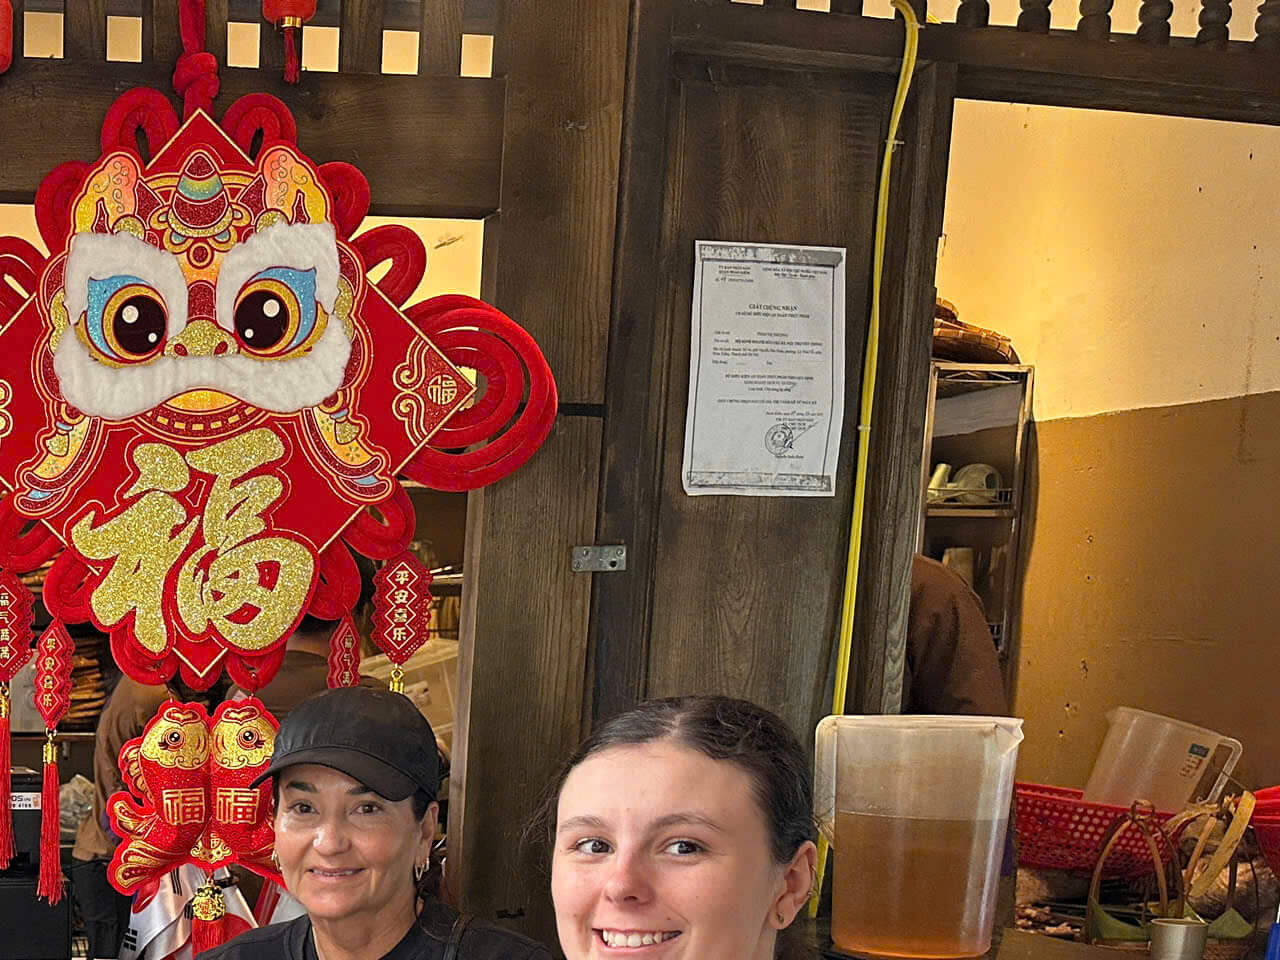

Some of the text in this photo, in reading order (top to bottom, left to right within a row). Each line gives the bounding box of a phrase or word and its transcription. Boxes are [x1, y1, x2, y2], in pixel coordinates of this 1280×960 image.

[71, 427, 315, 654] 福
[163, 787, 205, 825] 福
[217, 787, 260, 824] 福
